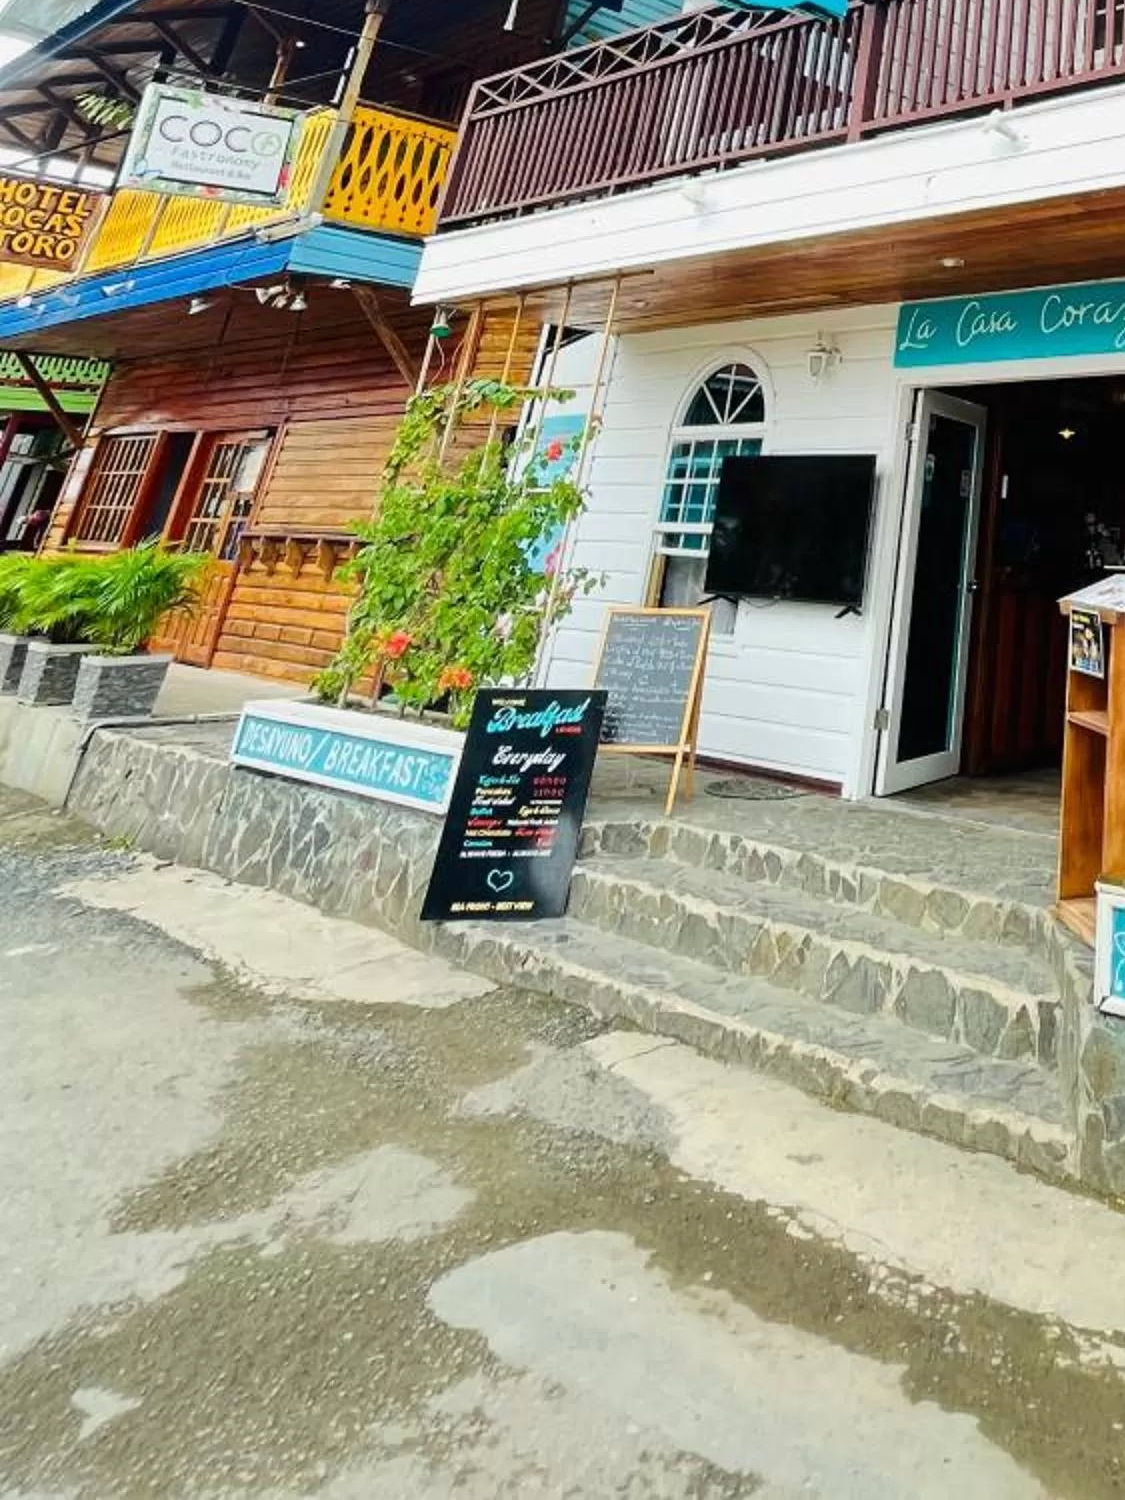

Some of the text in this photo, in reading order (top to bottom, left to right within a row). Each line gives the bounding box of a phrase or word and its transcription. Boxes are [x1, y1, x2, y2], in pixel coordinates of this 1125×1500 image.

[0, 177, 91, 218] HOTEL
[899, 308, 936, 351] La
[956, 301, 1018, 347] Casa
[323, 740, 430, 790] BREAKFAST
[491, 744, 568, 773] Everyday
